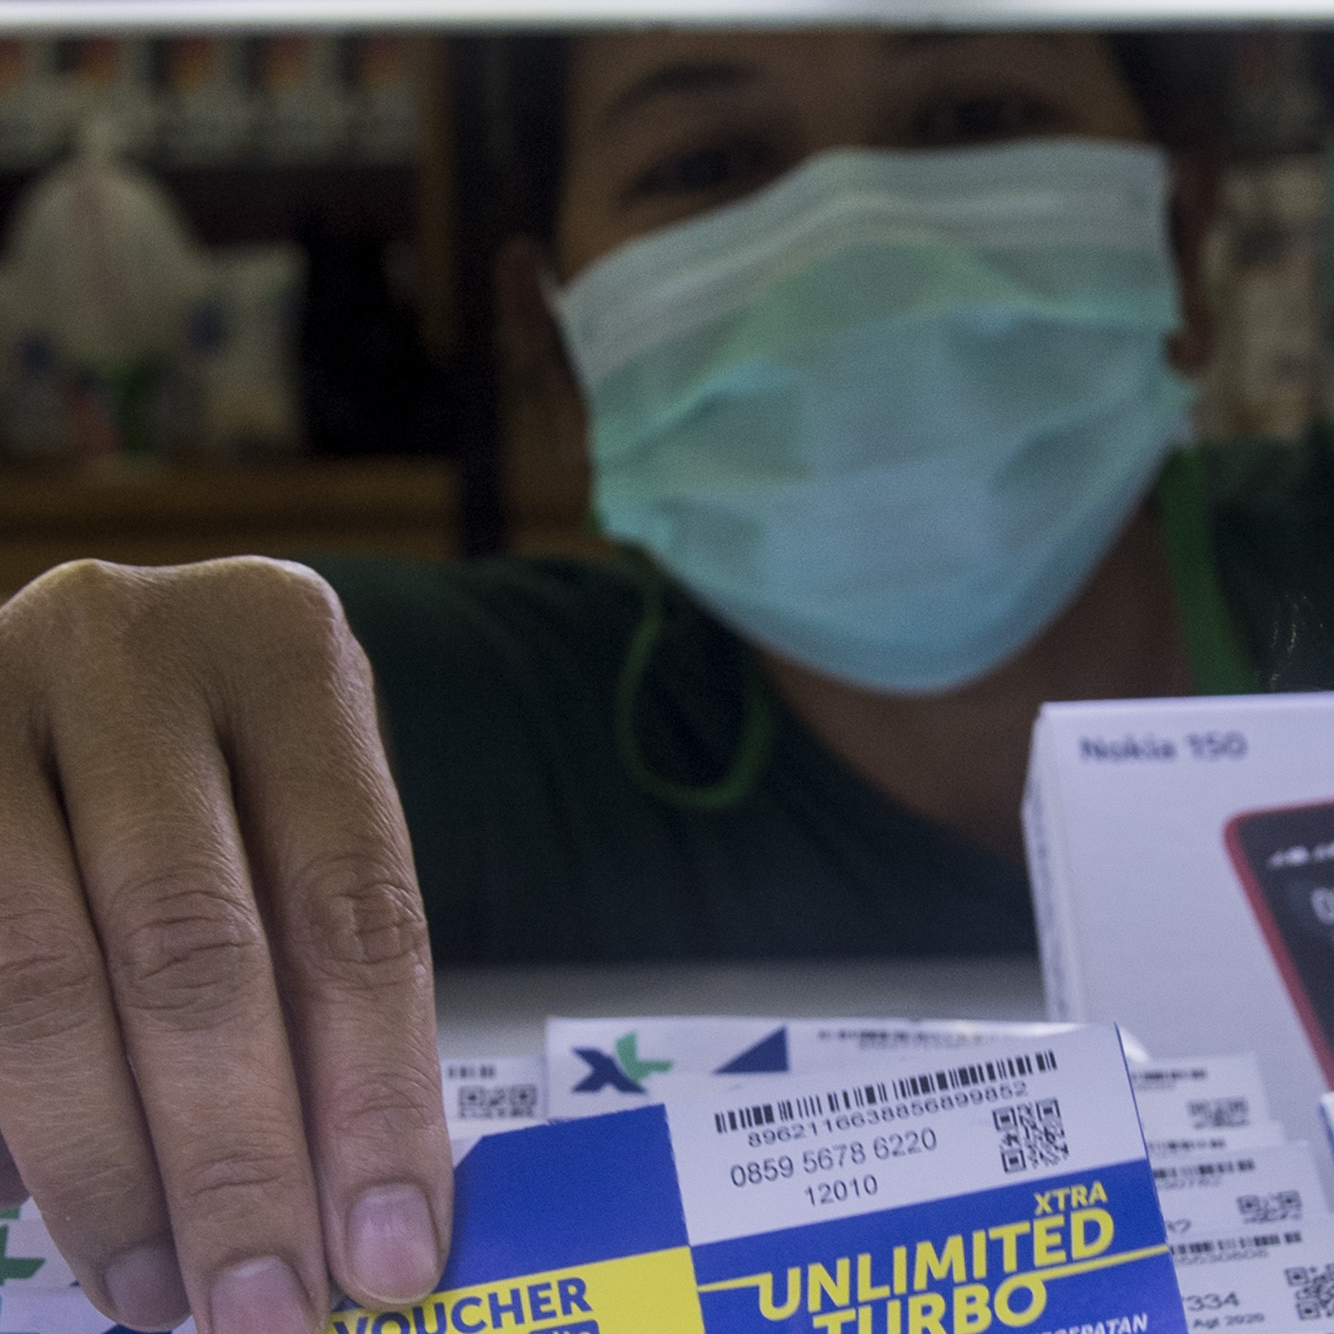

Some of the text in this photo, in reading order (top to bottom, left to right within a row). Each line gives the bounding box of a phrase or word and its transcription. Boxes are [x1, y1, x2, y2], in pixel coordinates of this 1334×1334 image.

[1079, 732, 1248, 763] Nokia 150
[747, 1080, 1029, 1149] 8962116638856899852
[729, 1126, 938, 1188] 0859 5678 6220
[804, 1173, 879, 1207] 12010
[1034, 1181, 1109, 1217] XTRA
[758, 1207, 1115, 1322] UNLIMITED
